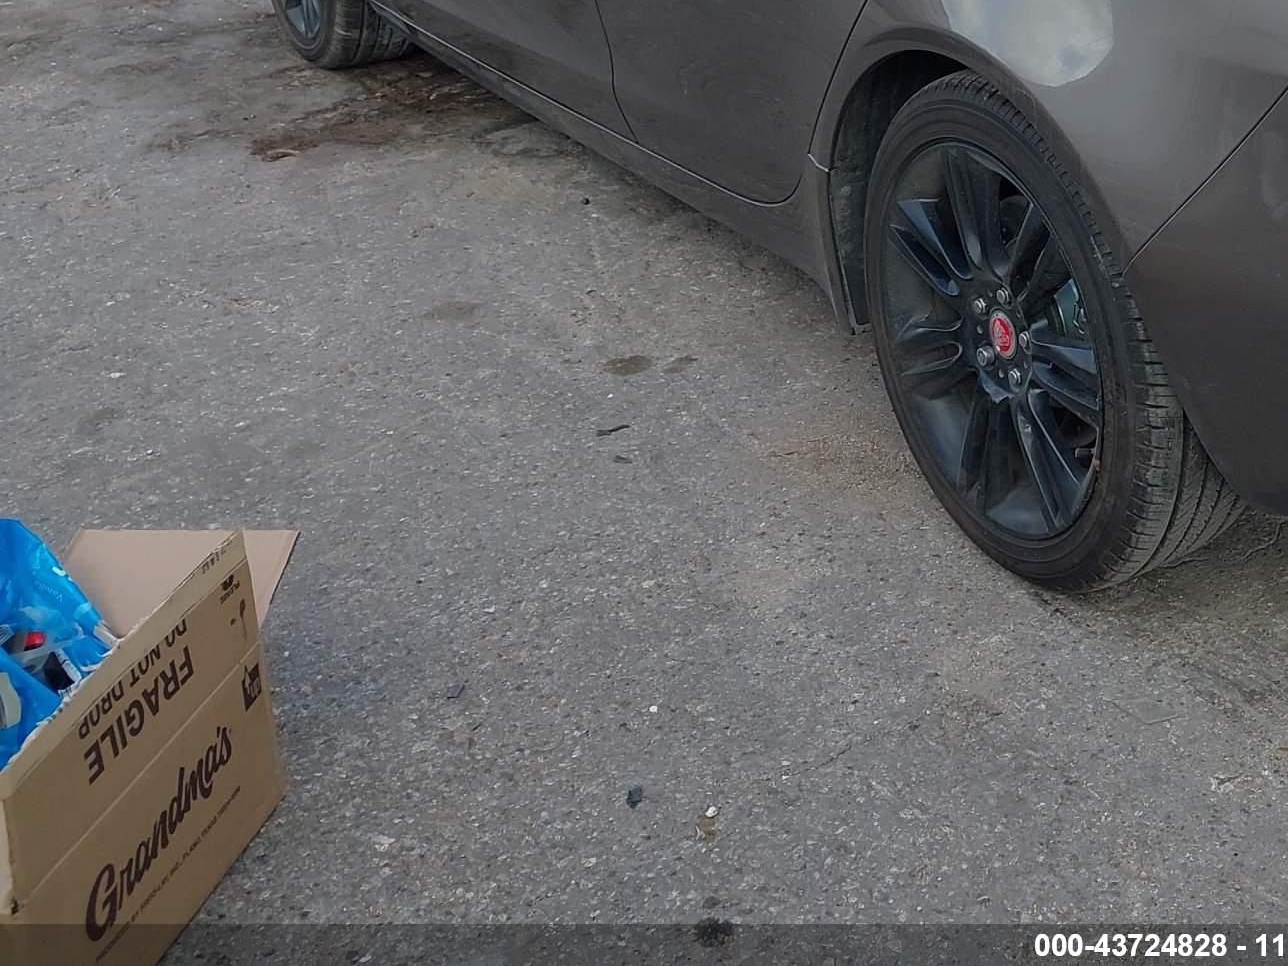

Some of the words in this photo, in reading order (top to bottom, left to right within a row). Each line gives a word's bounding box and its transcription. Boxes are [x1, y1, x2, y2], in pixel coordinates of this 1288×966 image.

[78, 680, 125, 739] DROP
[84, 645, 194, 785] FRAGILE
[85, 726, 232, 942] Grandma's
